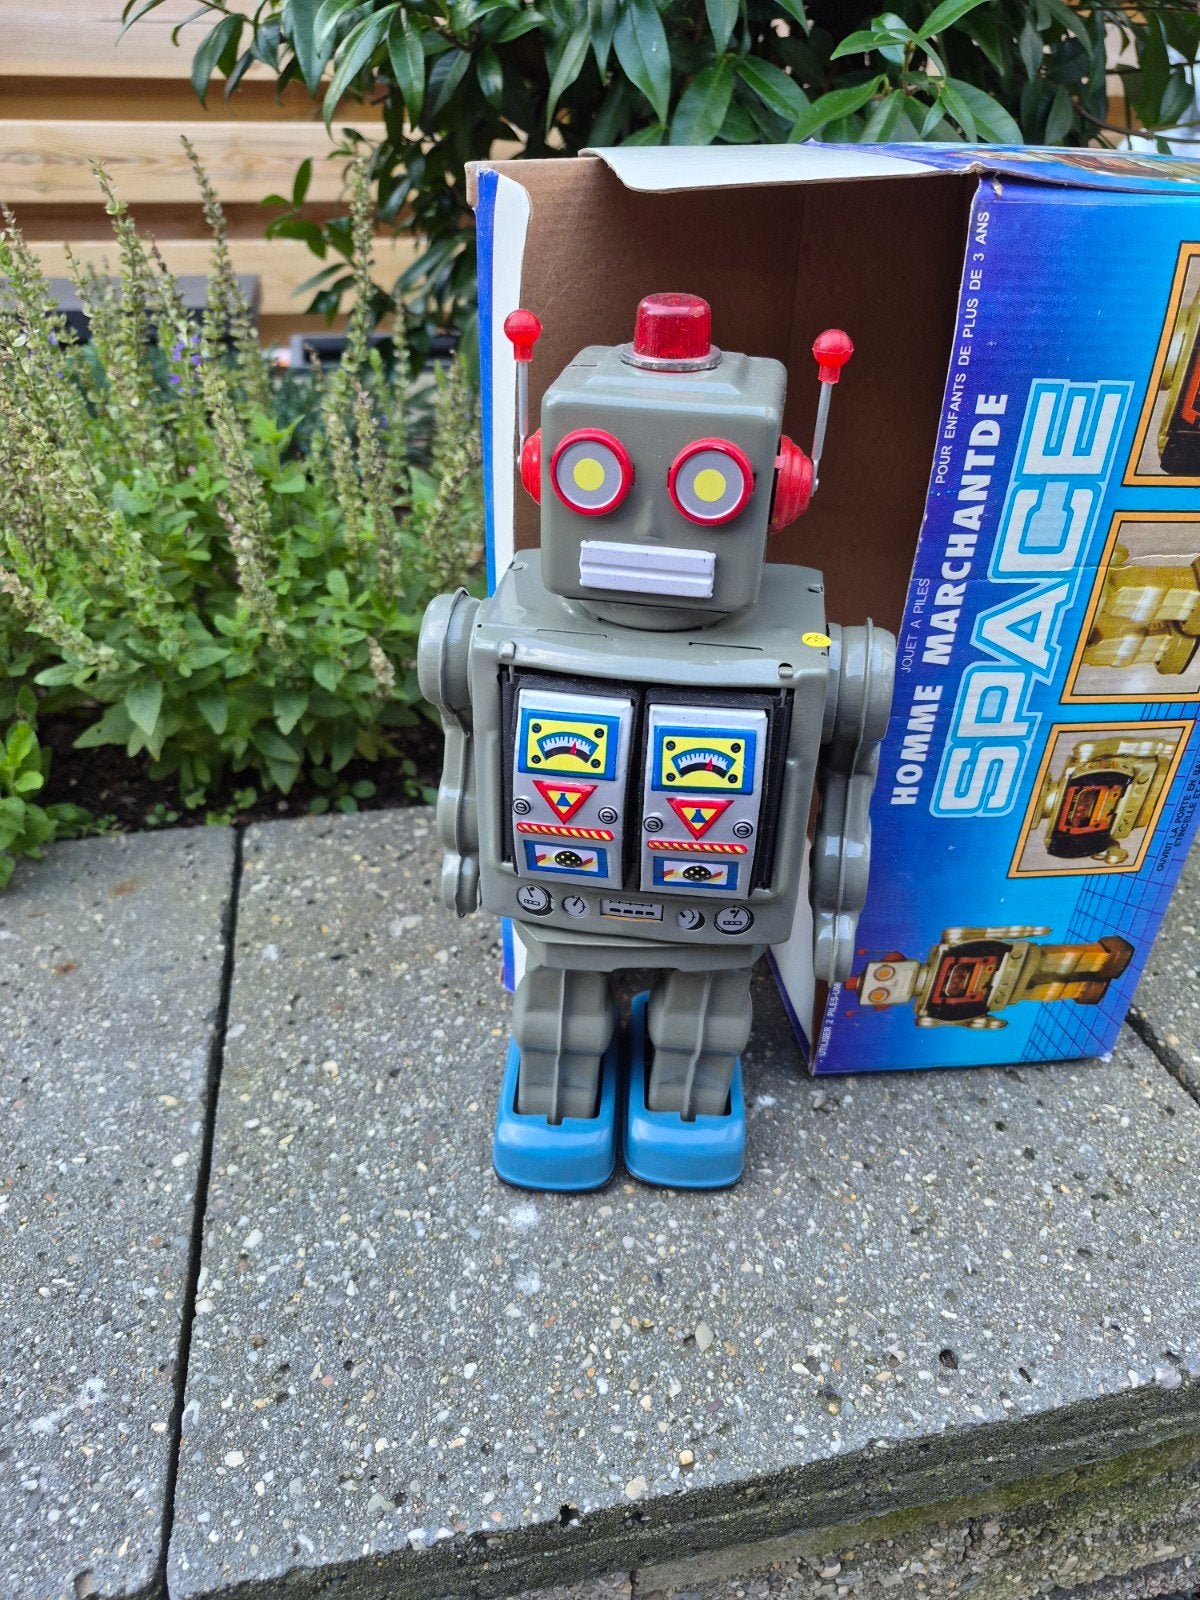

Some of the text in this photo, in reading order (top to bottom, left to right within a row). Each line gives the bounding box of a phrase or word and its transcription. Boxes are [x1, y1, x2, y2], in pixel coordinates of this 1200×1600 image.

[935, 211, 990, 484] POUR ENFANTS DE PLUS DE 3 ANS
[890, 394, 1009, 806] HOMME MARCHANTDE
[901, 578, 930, 673] JOUET A PILES
[929, 378, 1135, 818] SPACE
[1169, 827, 1178, 839] LA
[1174, 794, 1191, 823] PORTE
[818, 1026, 832, 1056] UTILISER
